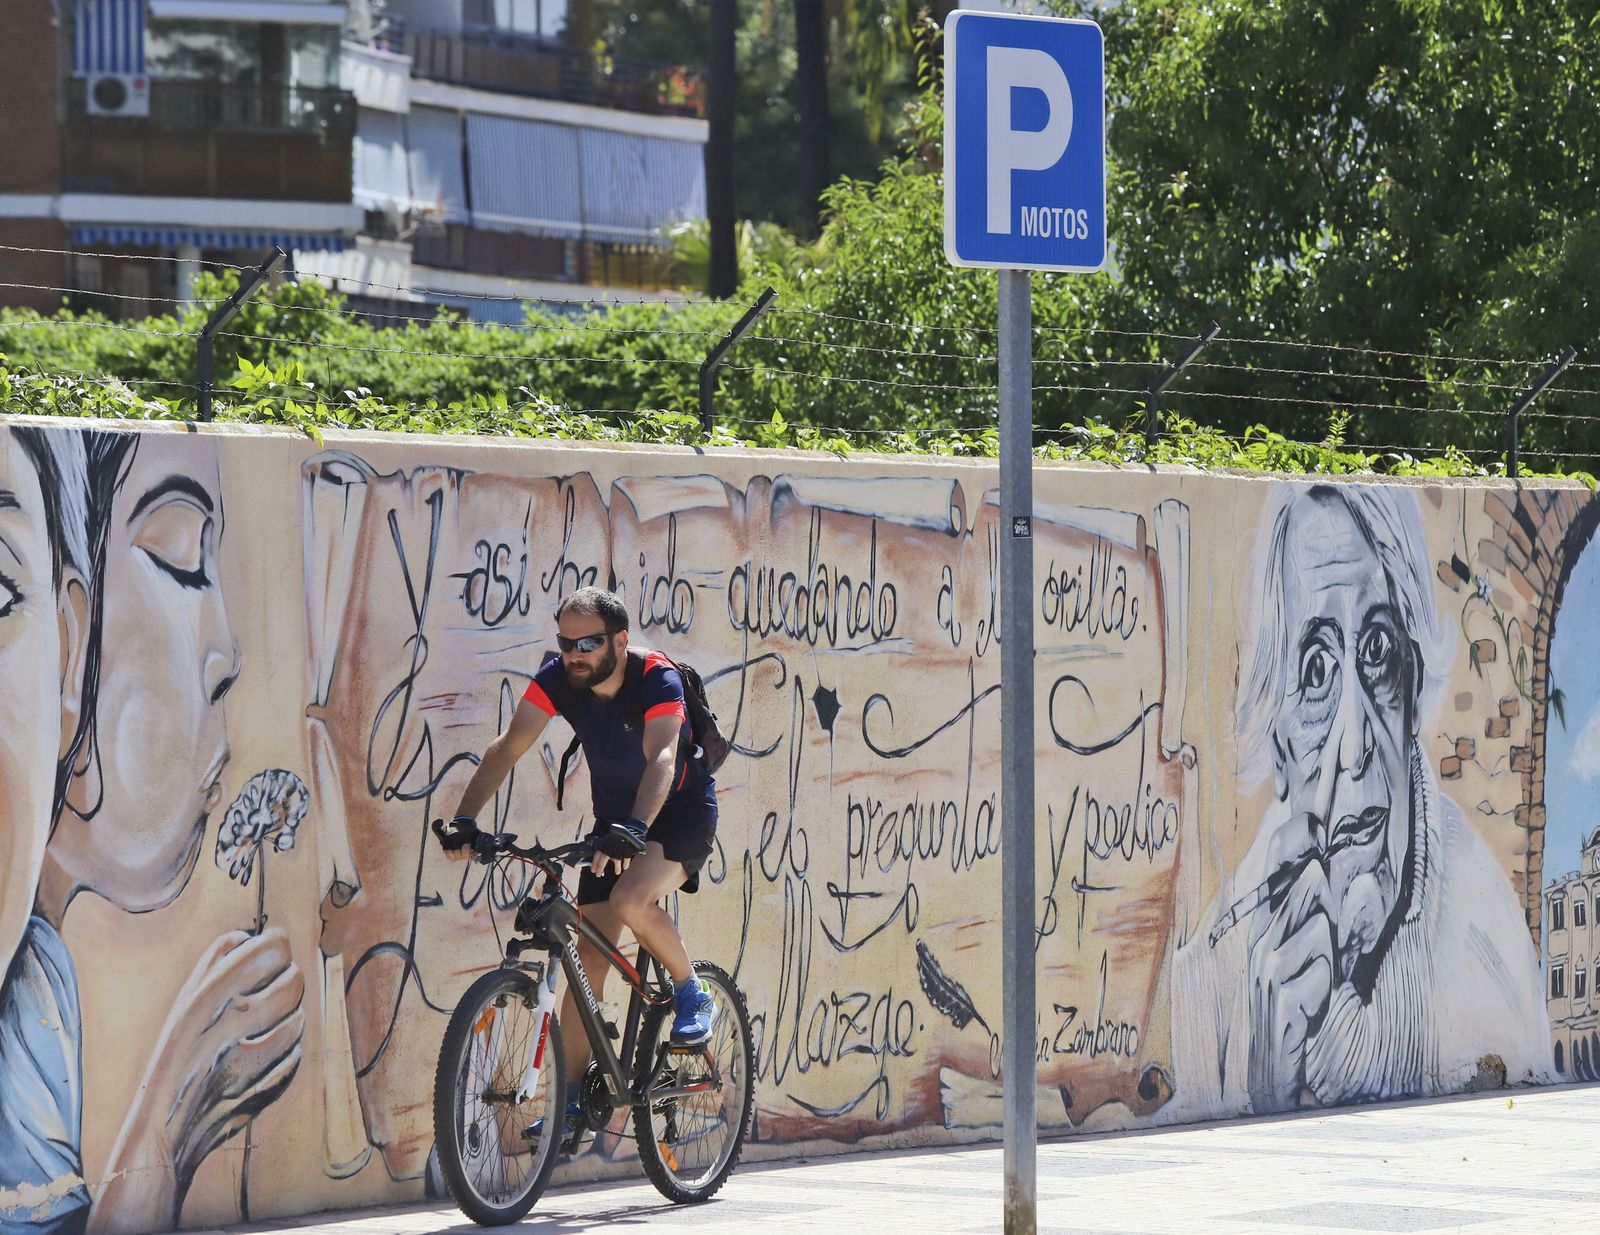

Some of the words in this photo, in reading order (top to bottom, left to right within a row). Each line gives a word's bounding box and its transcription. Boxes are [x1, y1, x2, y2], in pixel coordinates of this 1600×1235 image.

[986, 45, 1074, 234] P
[1021, 205, 1089, 240] MOTOS
[638, 510, 695, 634] ido
[566, 940, 601, 1016] ROCKRIDER
[1053, 950, 1140, 1060] Zambrano
